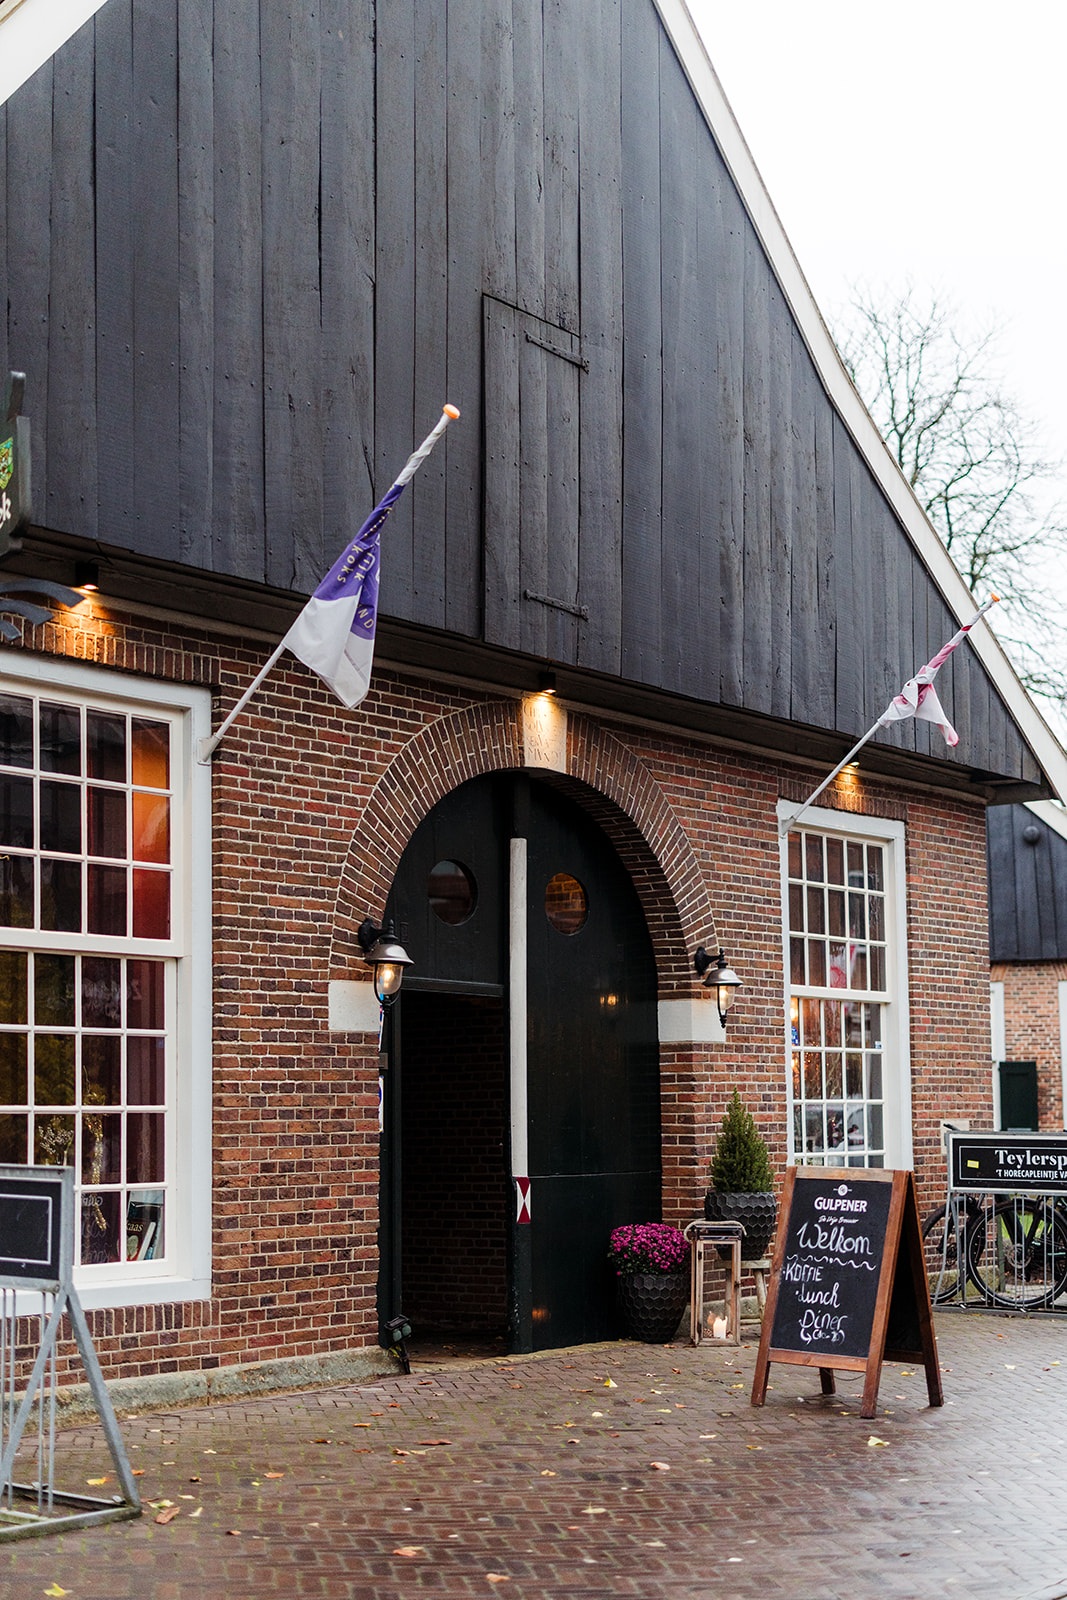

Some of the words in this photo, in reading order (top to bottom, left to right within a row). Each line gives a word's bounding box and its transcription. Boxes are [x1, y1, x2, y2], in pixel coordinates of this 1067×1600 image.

[337, 544, 364, 583] KOKS
[1003, 1170, 1058, 1180] HORECAPLEINTJE
[814, 1196, 868, 1213] GULPENER
[796, 1221, 874, 1256] Welkom
[799, 1309, 848, 1331] Diner
